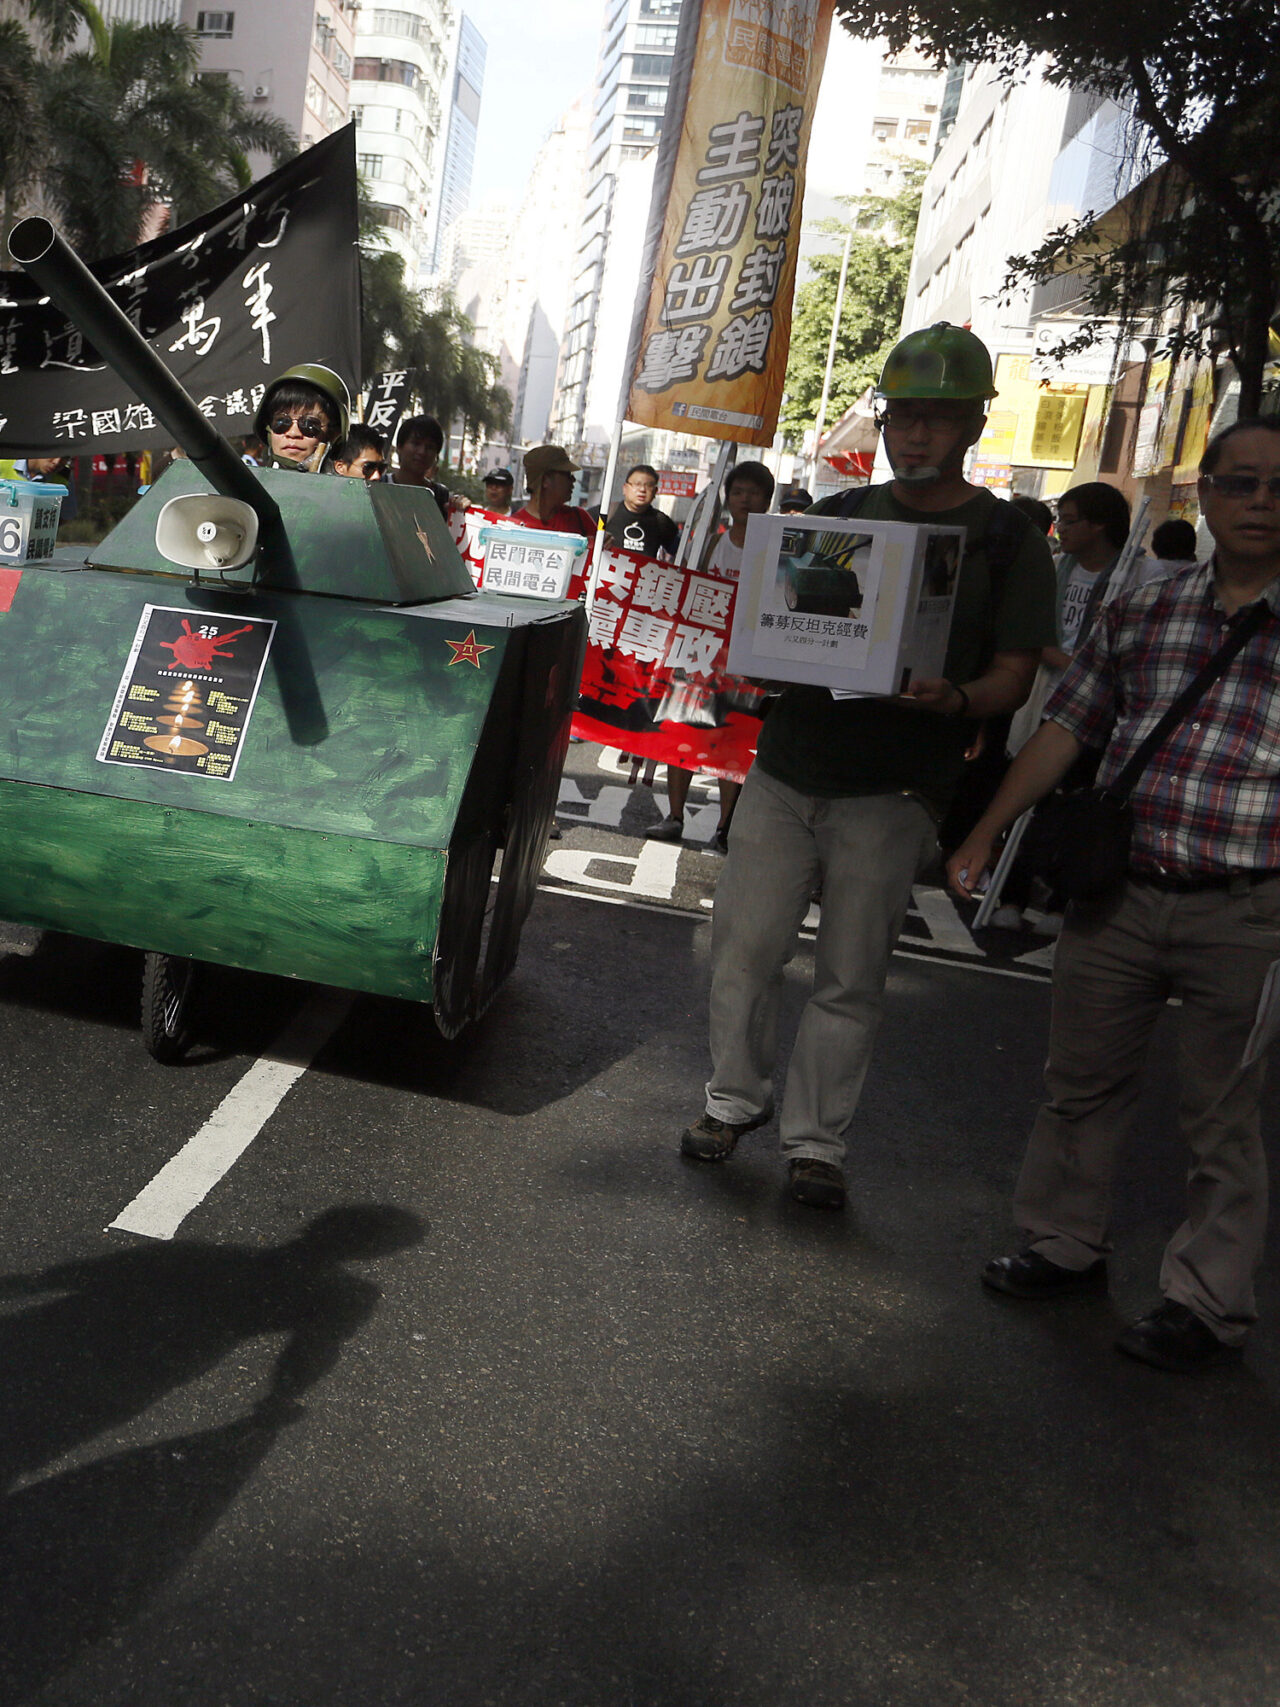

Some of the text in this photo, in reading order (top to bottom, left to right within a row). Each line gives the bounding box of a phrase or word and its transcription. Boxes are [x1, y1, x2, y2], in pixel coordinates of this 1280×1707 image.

[636, 111, 766, 394] 主動出擊
[703, 105, 804, 384] 突破封鎖
[52, 403, 157, 439] 梁國雄
[367, 369, 408, 438] 平反
[486, 567, 557, 593] 民間電台
[198, 625, 219, 636] 25
[760, 612, 869, 640] 籌募反坦克經費
